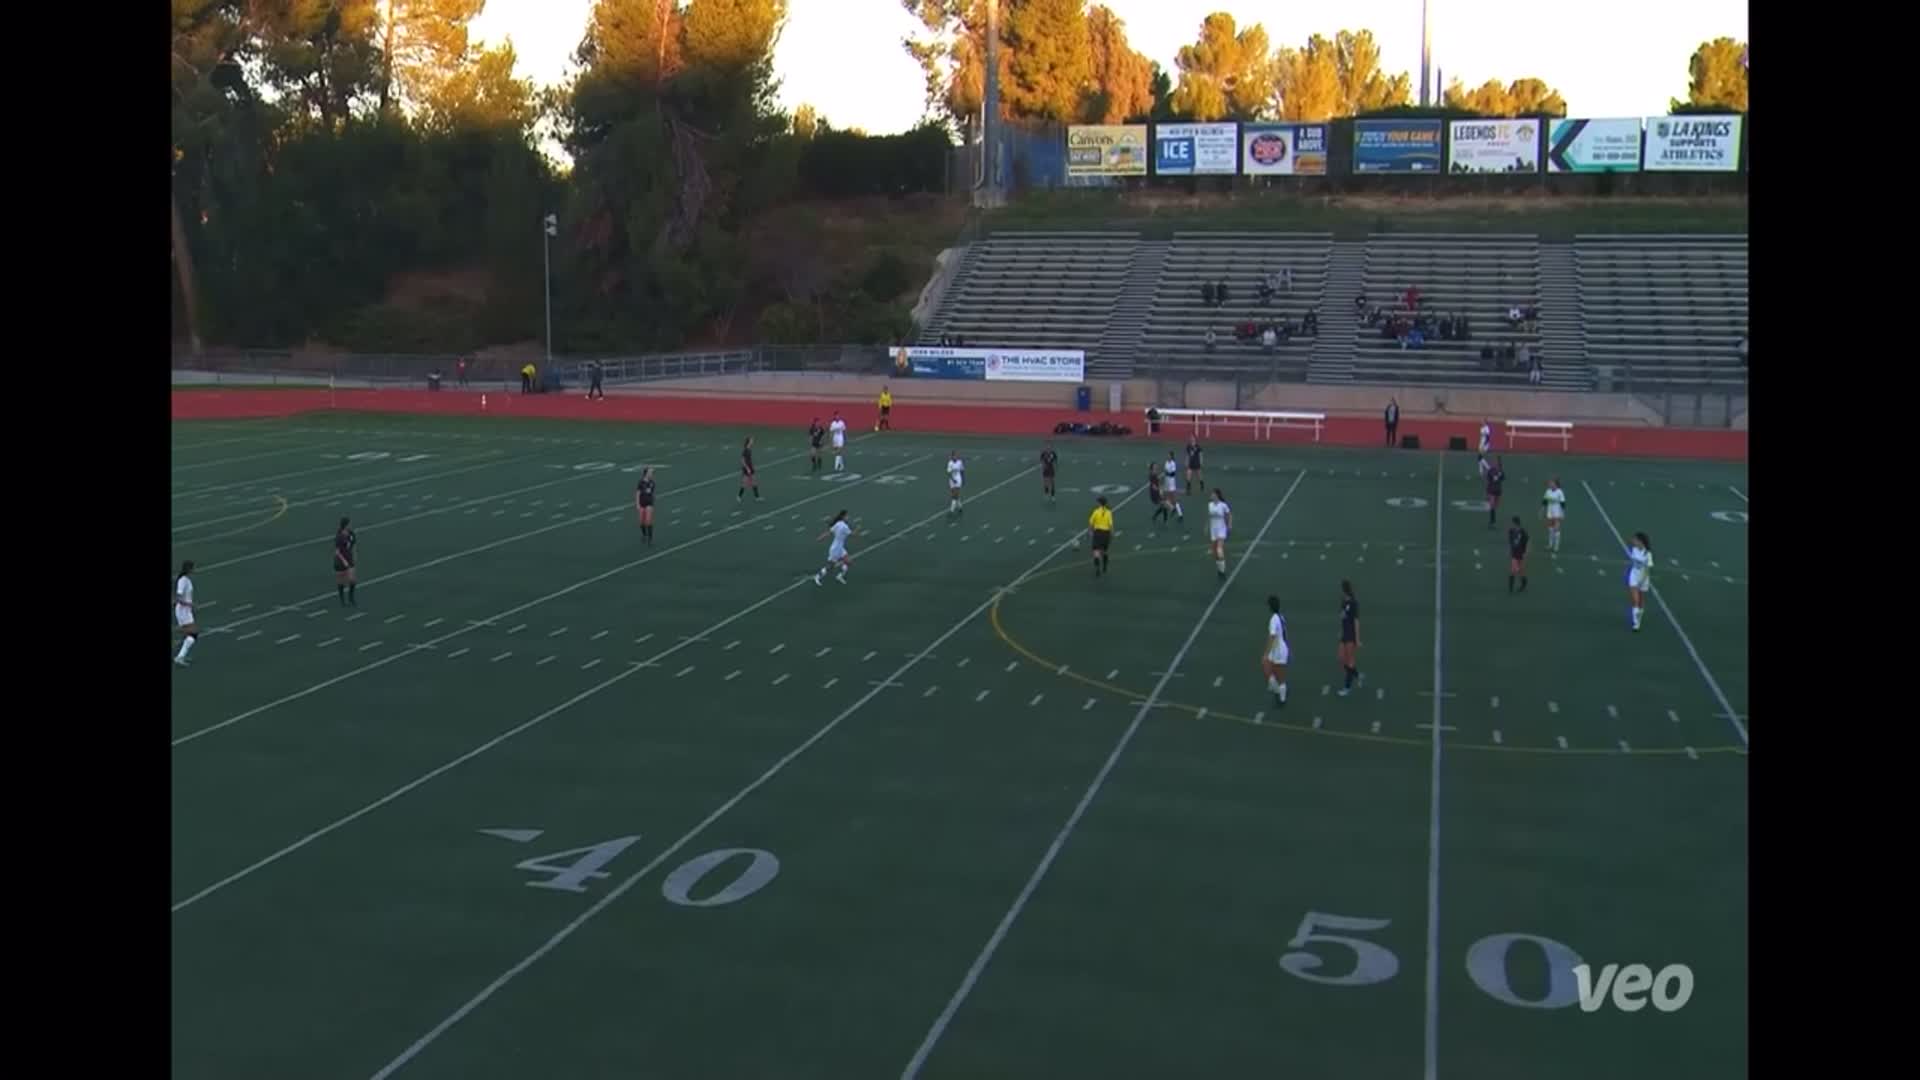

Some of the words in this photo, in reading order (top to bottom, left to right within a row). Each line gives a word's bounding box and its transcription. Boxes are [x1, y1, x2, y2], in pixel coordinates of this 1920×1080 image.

[1454, 126, 1496, 141] LEGENDS
[1671, 123, 1692, 137] LA
[1692, 121, 1732, 138] KINGS
[1670, 138, 1716, 147] SUPPORTS
[1163, 141, 1189, 158] ICE
[1661, 149, 1724, 160] ATHLETICS
[1002, 356, 1019, 365] THE
[1022, 356, 1048, 365] HVAC
[1050, 357, 1081, 366] STORE
